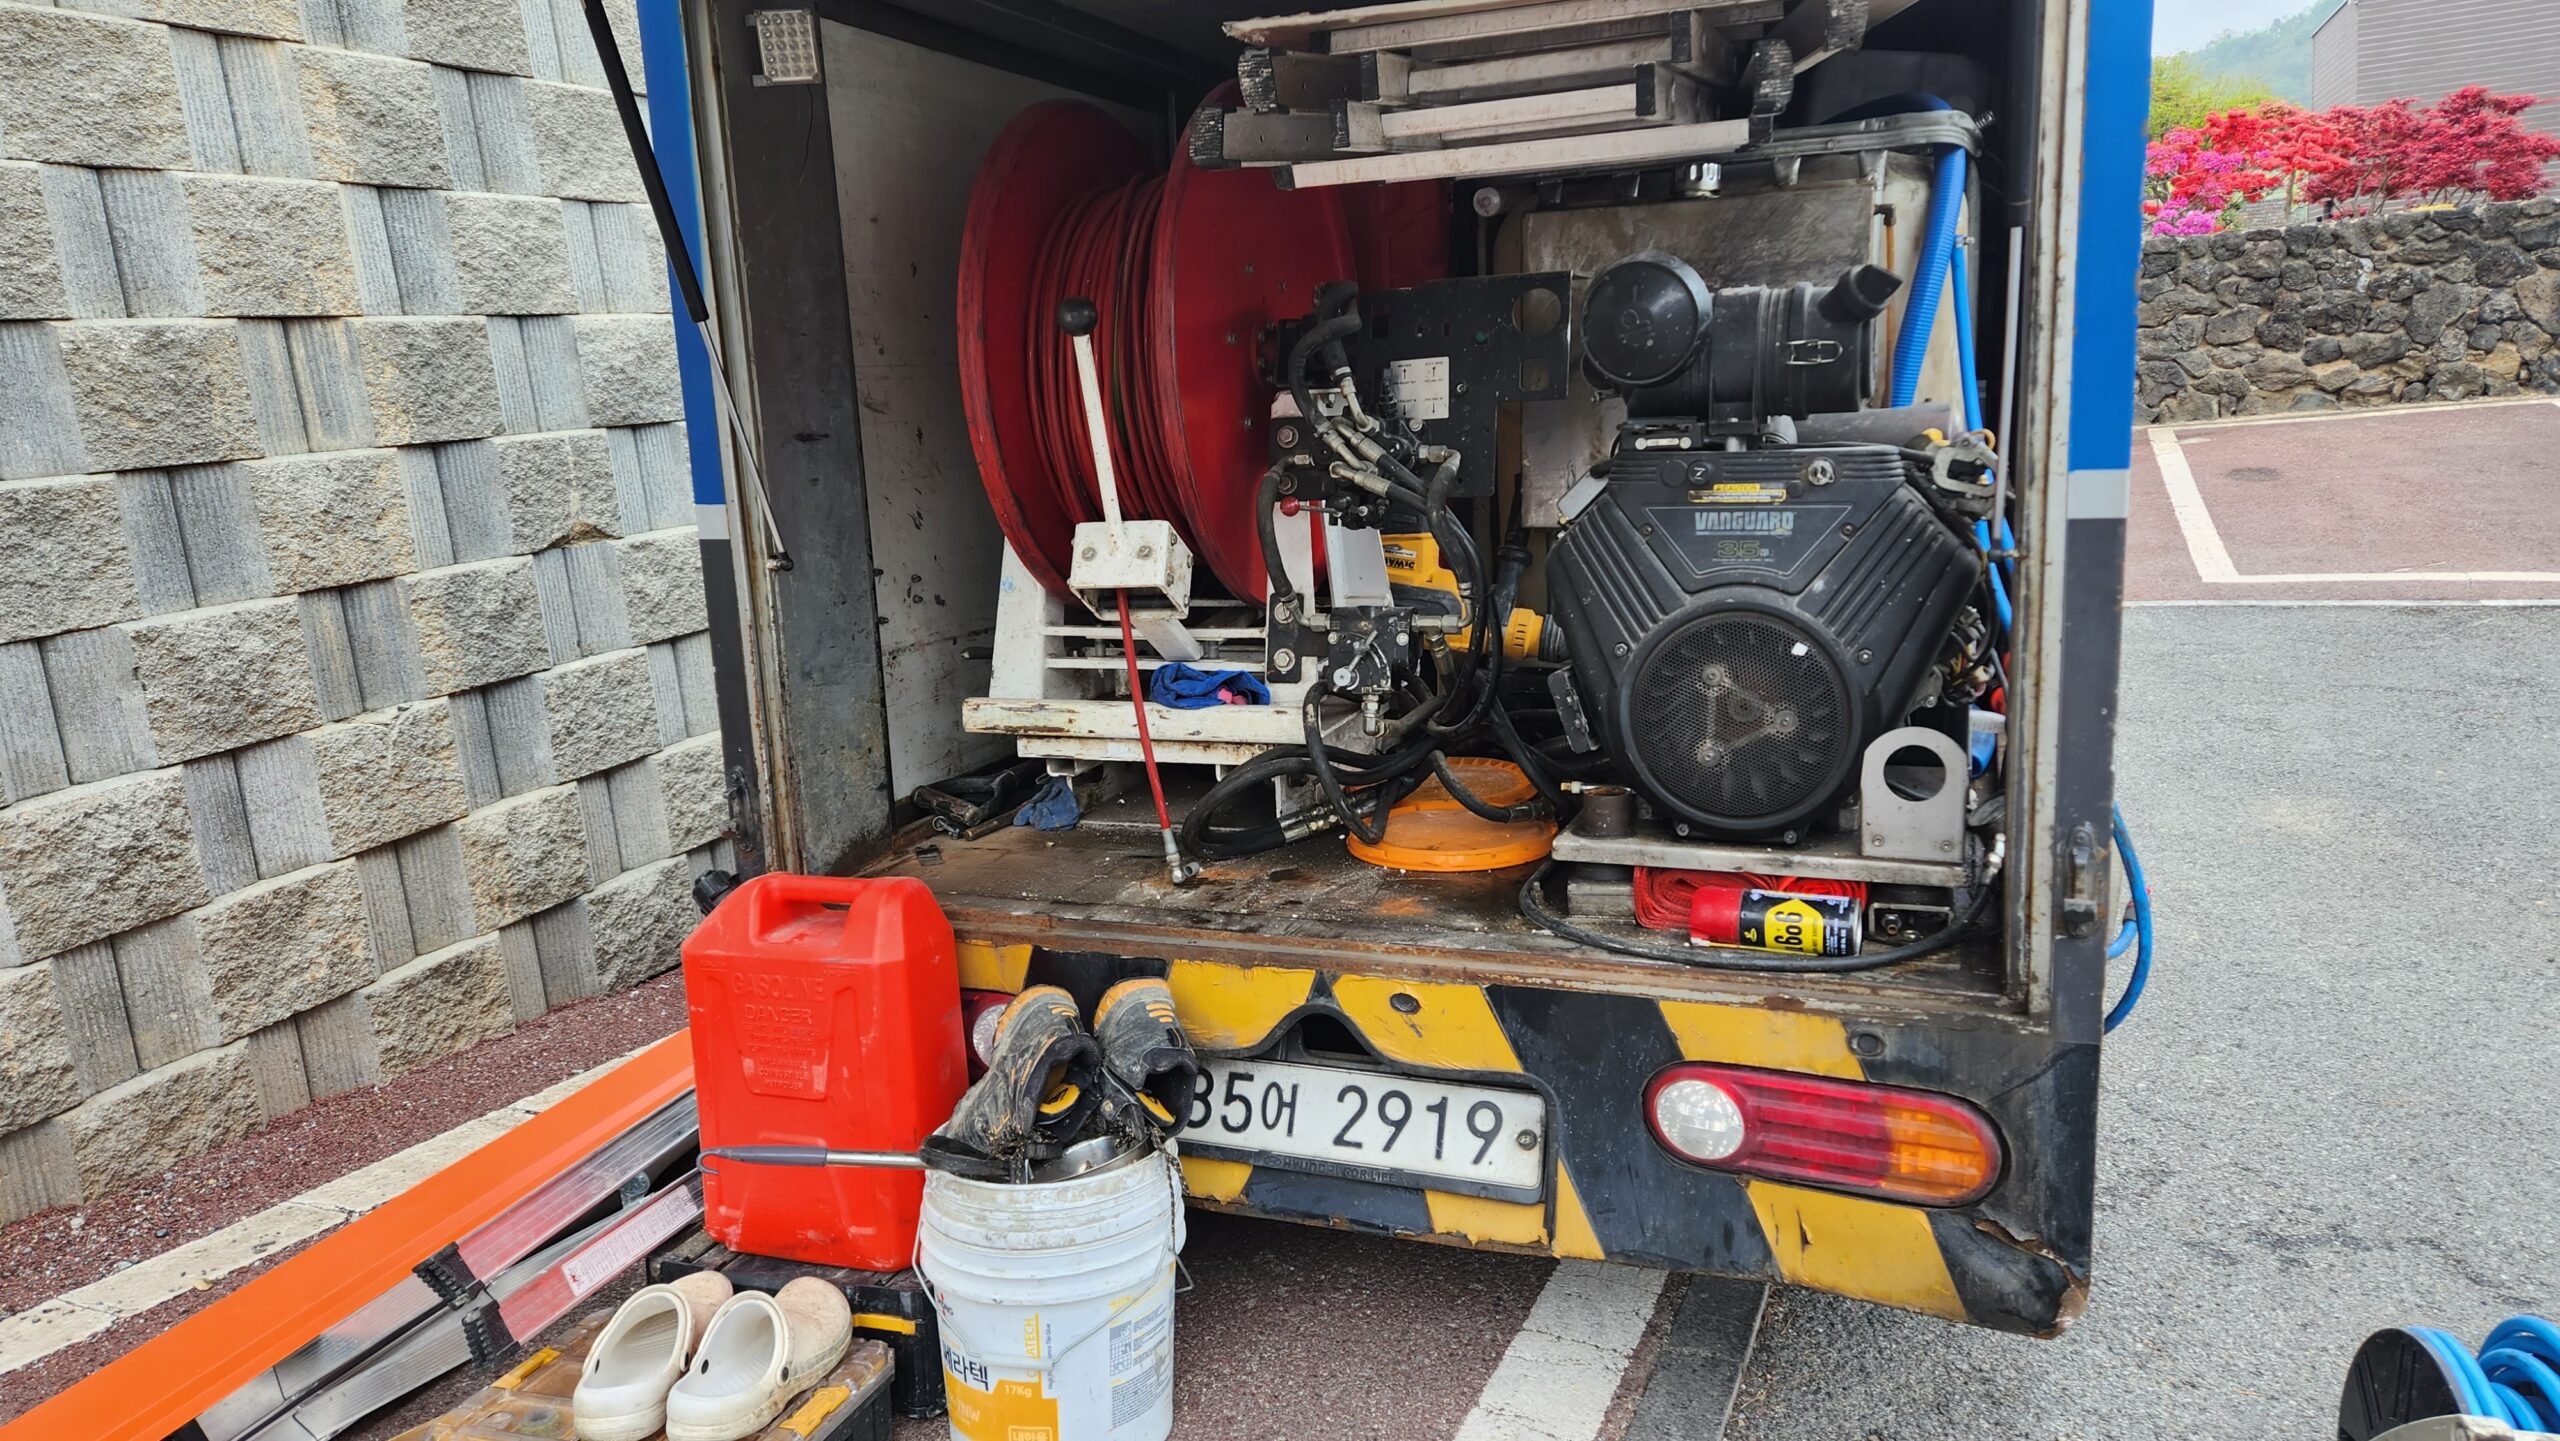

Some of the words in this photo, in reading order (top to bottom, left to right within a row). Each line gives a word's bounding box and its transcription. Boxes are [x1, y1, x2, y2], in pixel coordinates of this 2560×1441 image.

[1695, 512, 1794, 530] VANGUARD
[1717, 540, 1760, 558] 35
[1385, 558, 1415, 570] DEWA
[731, 971, 825, 1001] GASOLINE
[744, 1003, 813, 1025] DANGER
[1187, 1067, 1299, 1137] 85어
[1334, 1084, 1504, 1166] 2919
[1004, 1385, 1032, 1398] 17Kg
